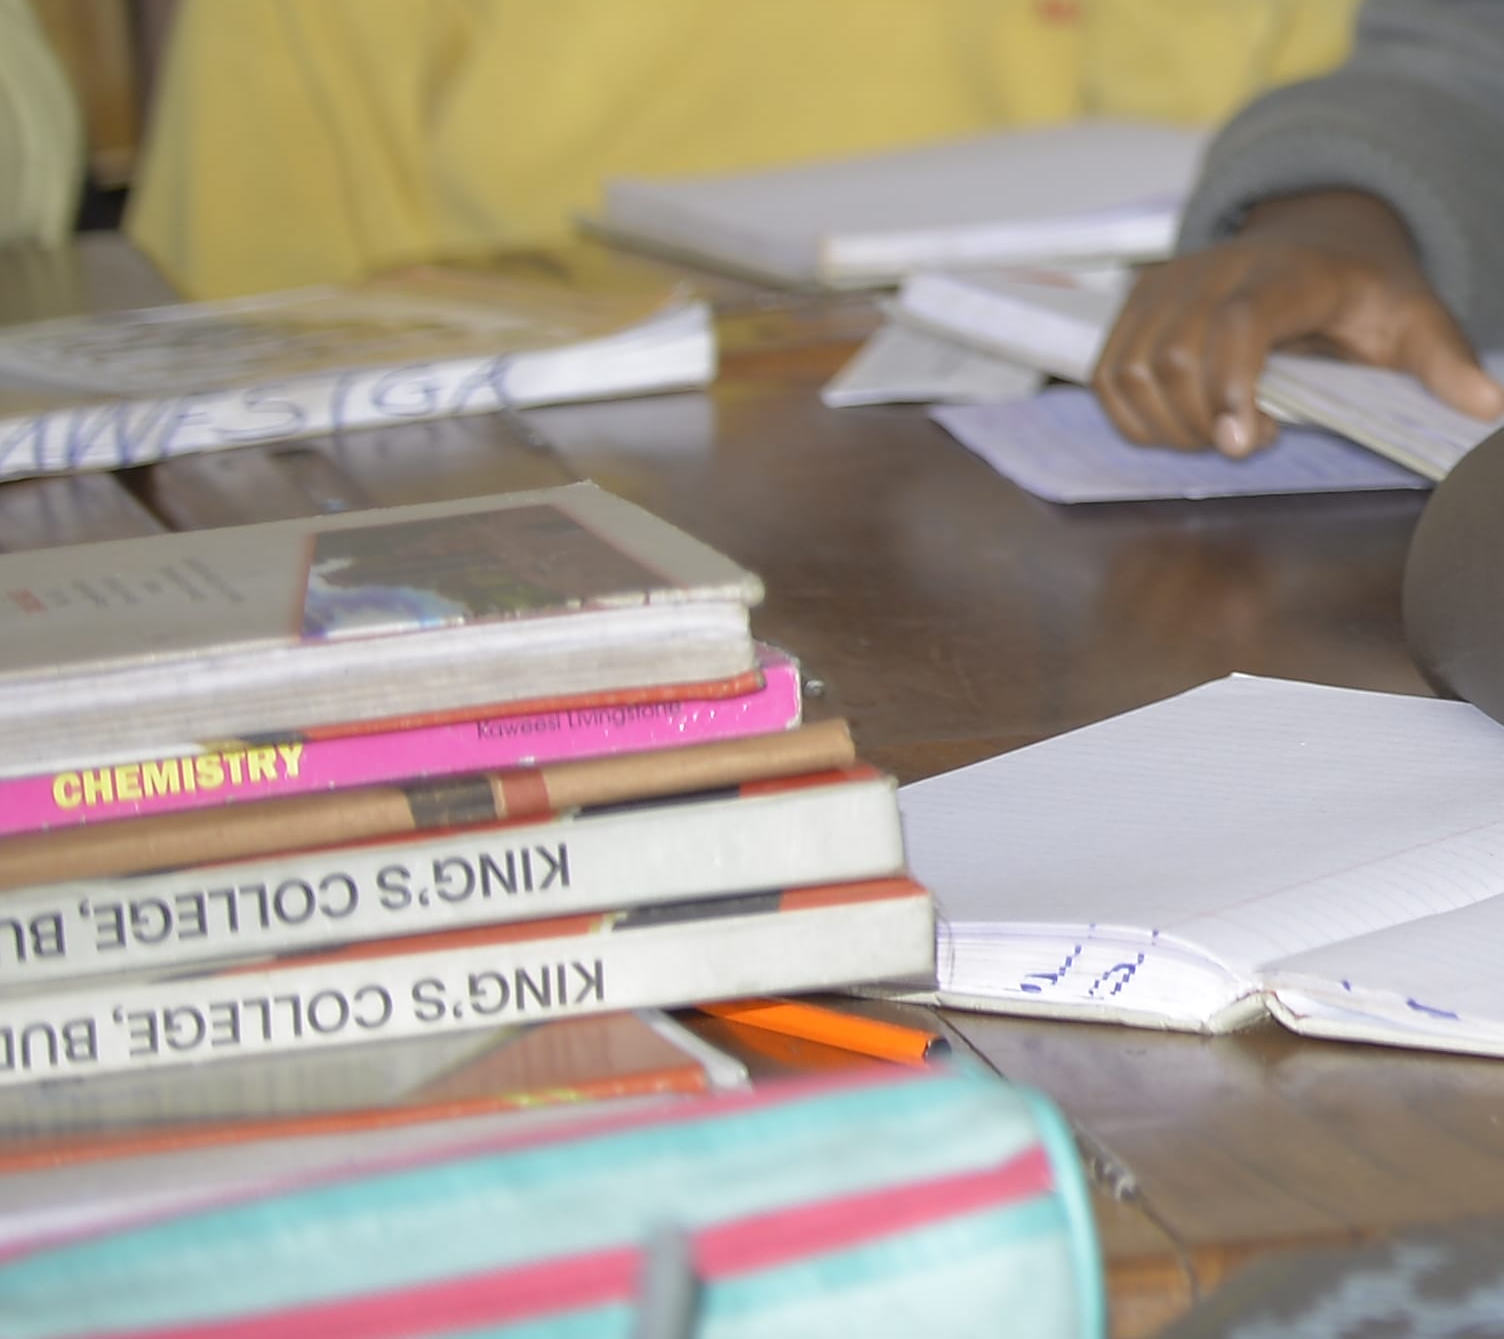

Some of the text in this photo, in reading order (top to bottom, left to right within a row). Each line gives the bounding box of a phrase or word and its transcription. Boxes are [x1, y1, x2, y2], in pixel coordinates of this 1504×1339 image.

[52, 742, 304, 810] CHEMISTRY
[376, 842, 572, 911] KING'S
[79, 872, 360, 952] COLLEGE,
[112, 983, 394, 1058] COLLEGE,
[411, 958, 606, 1023] KING'S
